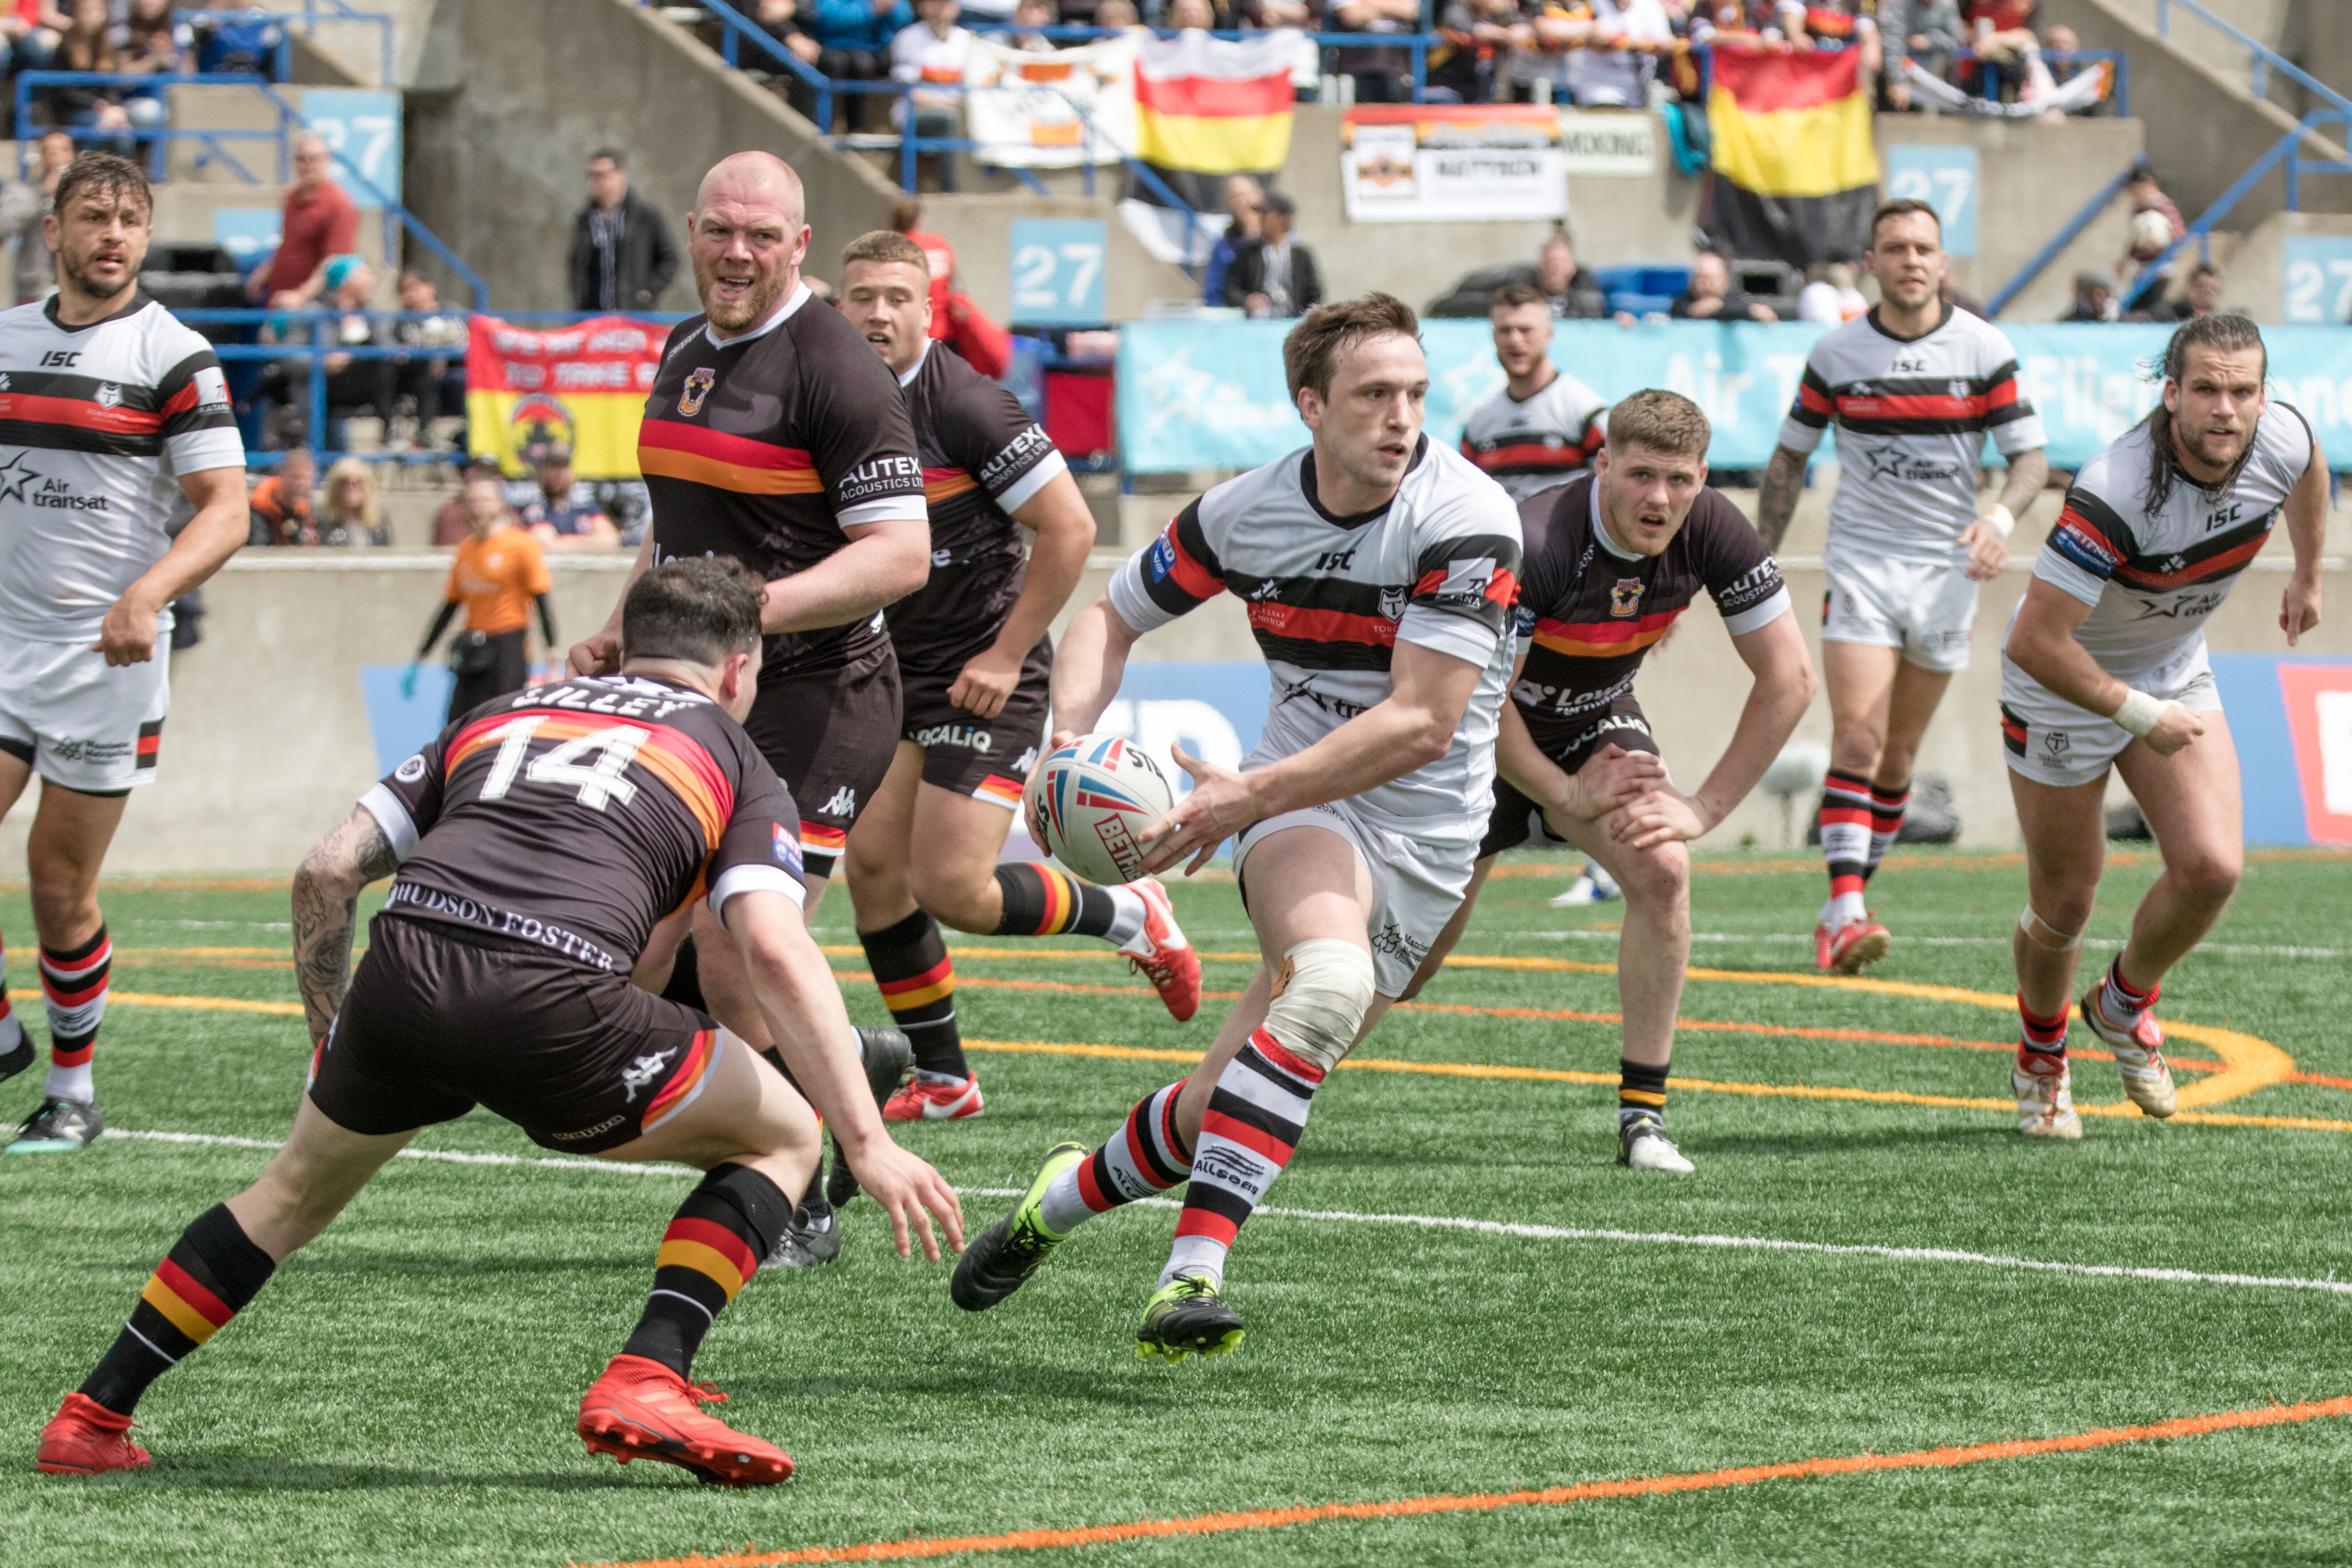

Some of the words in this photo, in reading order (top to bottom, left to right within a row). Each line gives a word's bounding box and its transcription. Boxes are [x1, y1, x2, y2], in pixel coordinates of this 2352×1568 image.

[1014, 243, 1103, 308] 27
[39, 350, 82, 367] ISC
[1891, 359, 1926, 372] ISC
[86, 408, 127, 421] TORONTO
[979, 423, 1042, 480] AUTEX
[1033, 440, 1049, 456] LTD
[838, 457, 921, 488] AUTEX
[43, 477, 70, 493] Air
[841, 477, 910, 501] ACOUSTICS
[910, 476, 924, 488] LTD
[32, 492, 109, 511] transat
[2205, 503, 2242, 532] ISC
[2064, 522, 2118, 563] BETFRED
[1315, 549, 1356, 571] ISC
[1267, 610, 1285, 618] LEAF
[480, 715, 651, 812] 14
[397, 883, 497, 927] HUDSON
[501, 911, 613, 971] FOSTER
